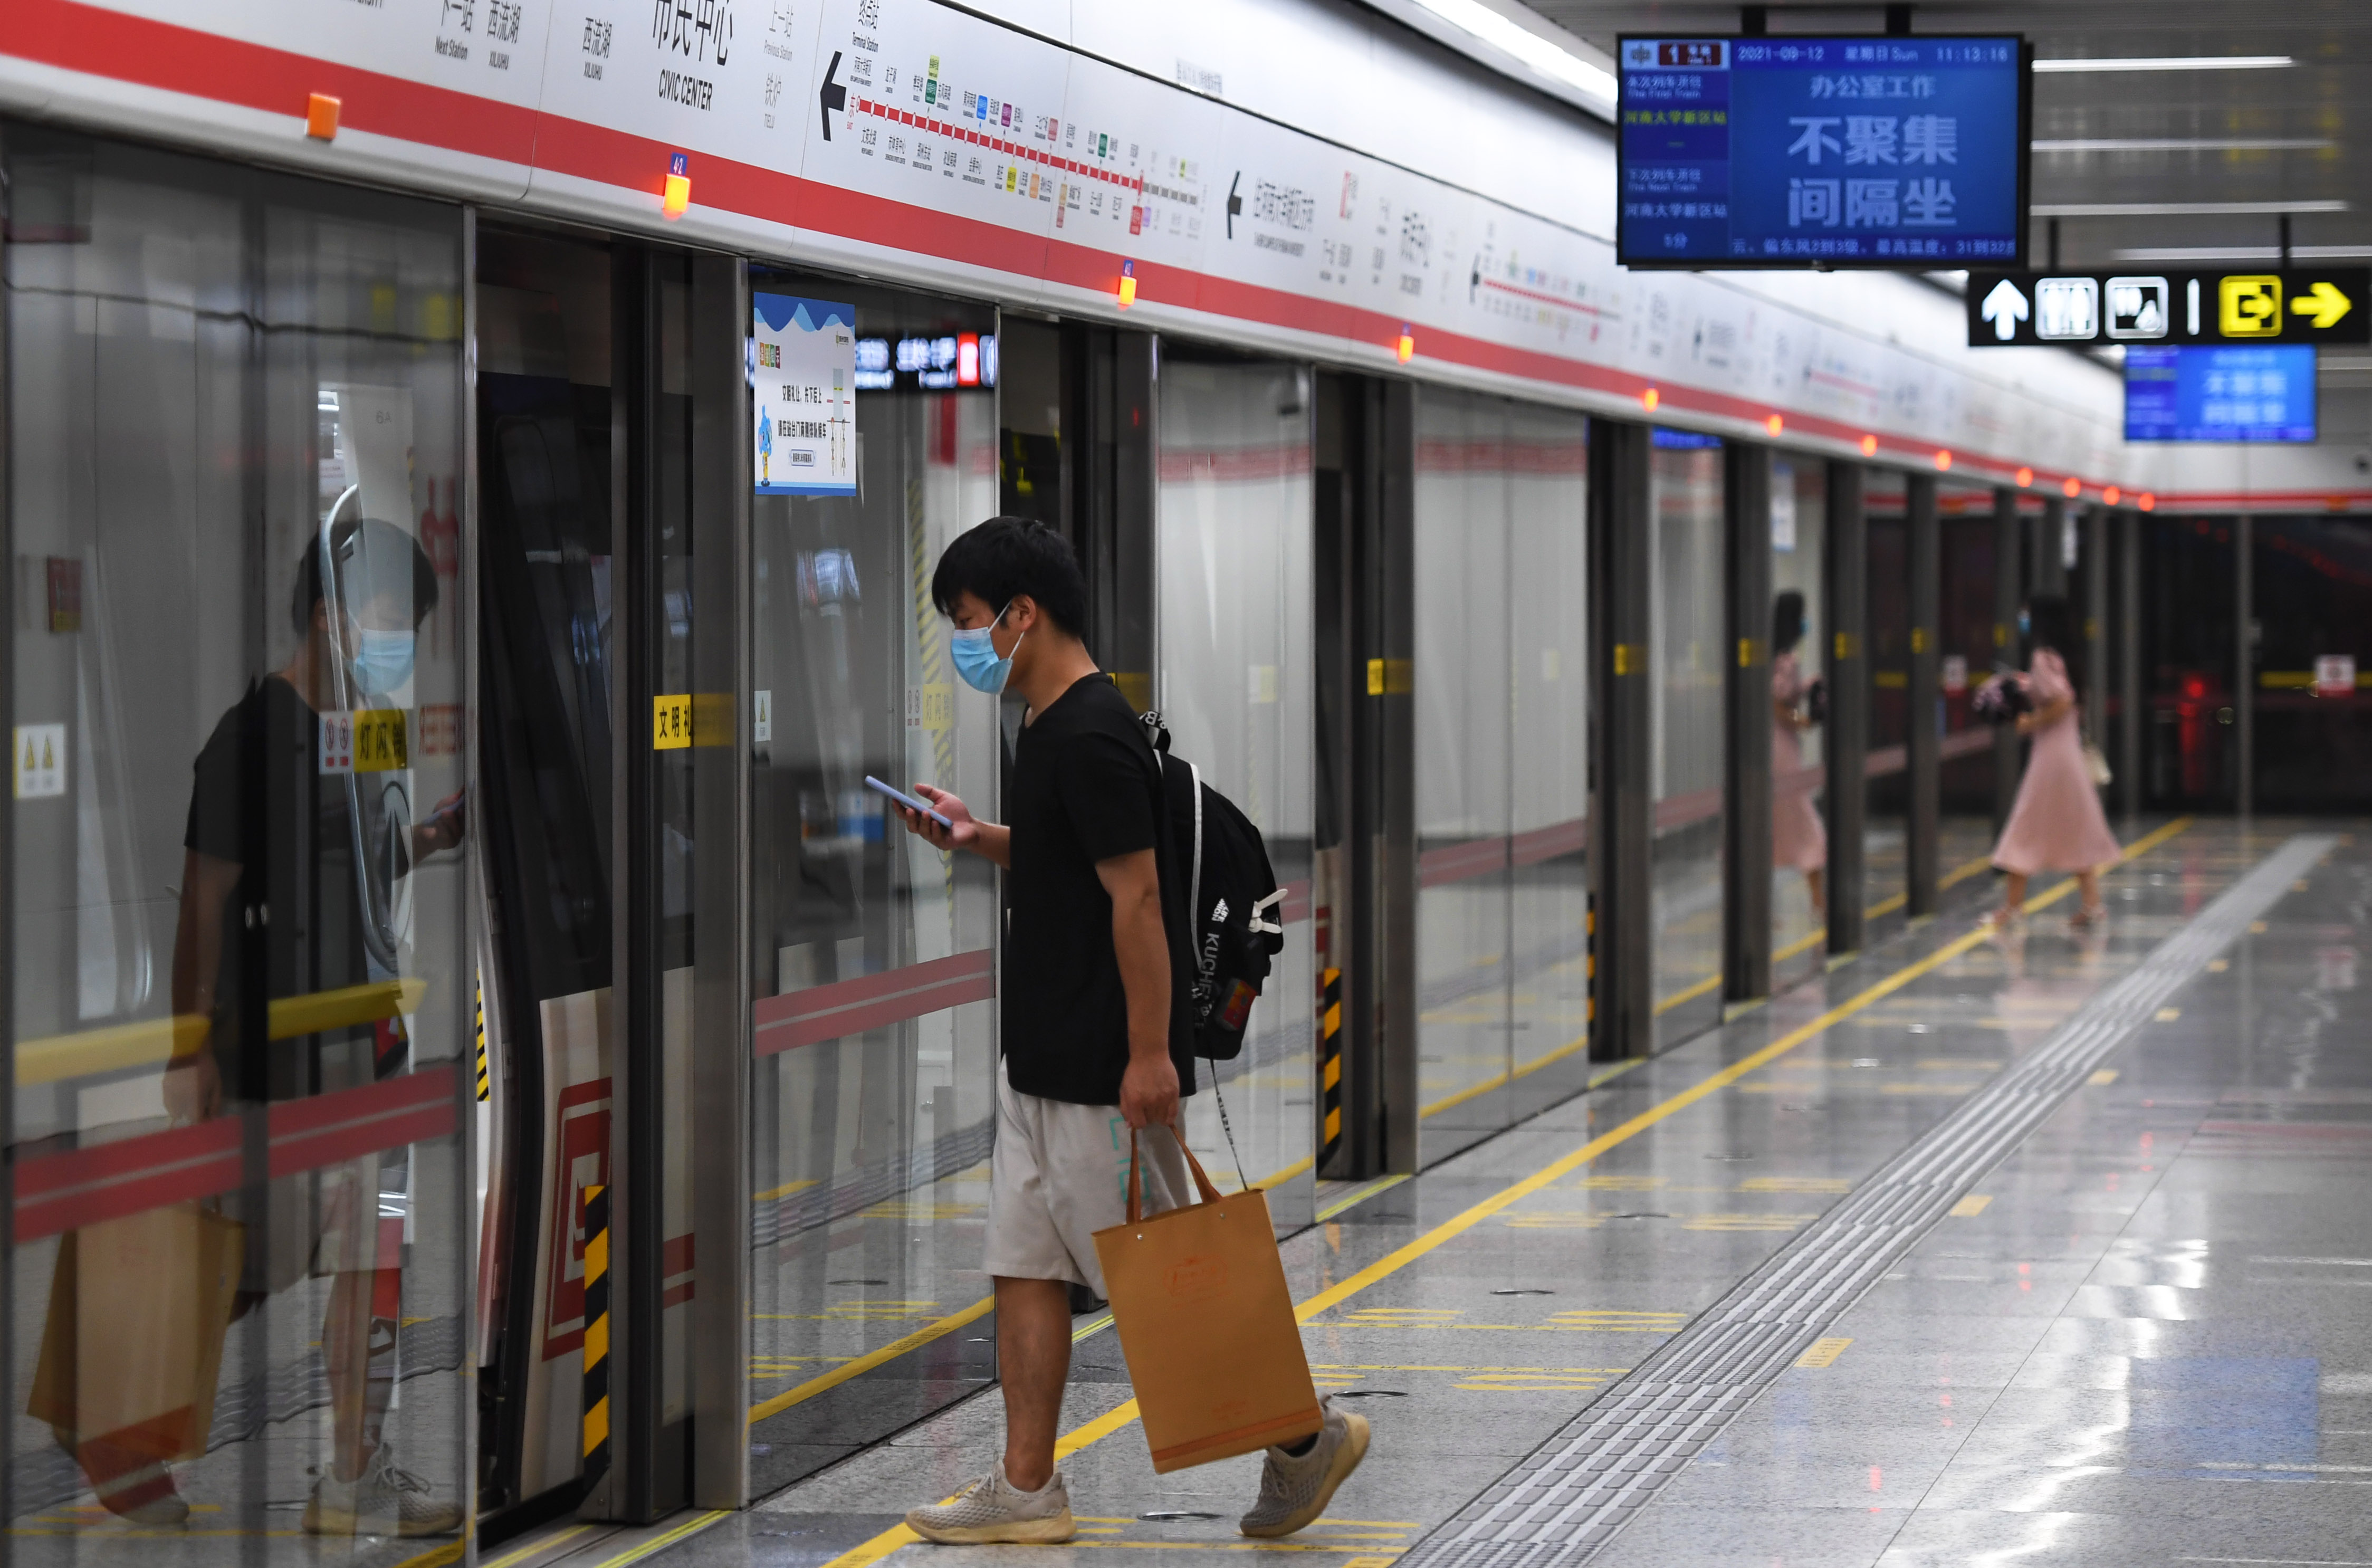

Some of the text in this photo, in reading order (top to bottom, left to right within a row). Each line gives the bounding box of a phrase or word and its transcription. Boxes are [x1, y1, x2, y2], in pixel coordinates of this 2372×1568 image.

[441, 0, 474, 33] 下一站
[487, 0, 521, 44] 西流湖
[769, 1, 793, 39] 上一站
[435, 35, 468, 60] Next Station
[582, 17, 612, 59] 西流湖
[780, 45, 792, 62] Station
[1738, 46, 1824, 62] 2021-09-12
[489, 50, 509, 70] XILIUHU
[584, 61, 602, 81] XILIUHU
[658, 69, 713, 111] CIVIC CENTER
[765, 73, 781, 108] 铁炉
[1809, 74, 1936, 100] 办公室工作
[1787, 114, 1957, 166] 不聚集
[1787, 176, 1957, 228] 间隔坐
[659, 705, 692, 739] 文明礼
